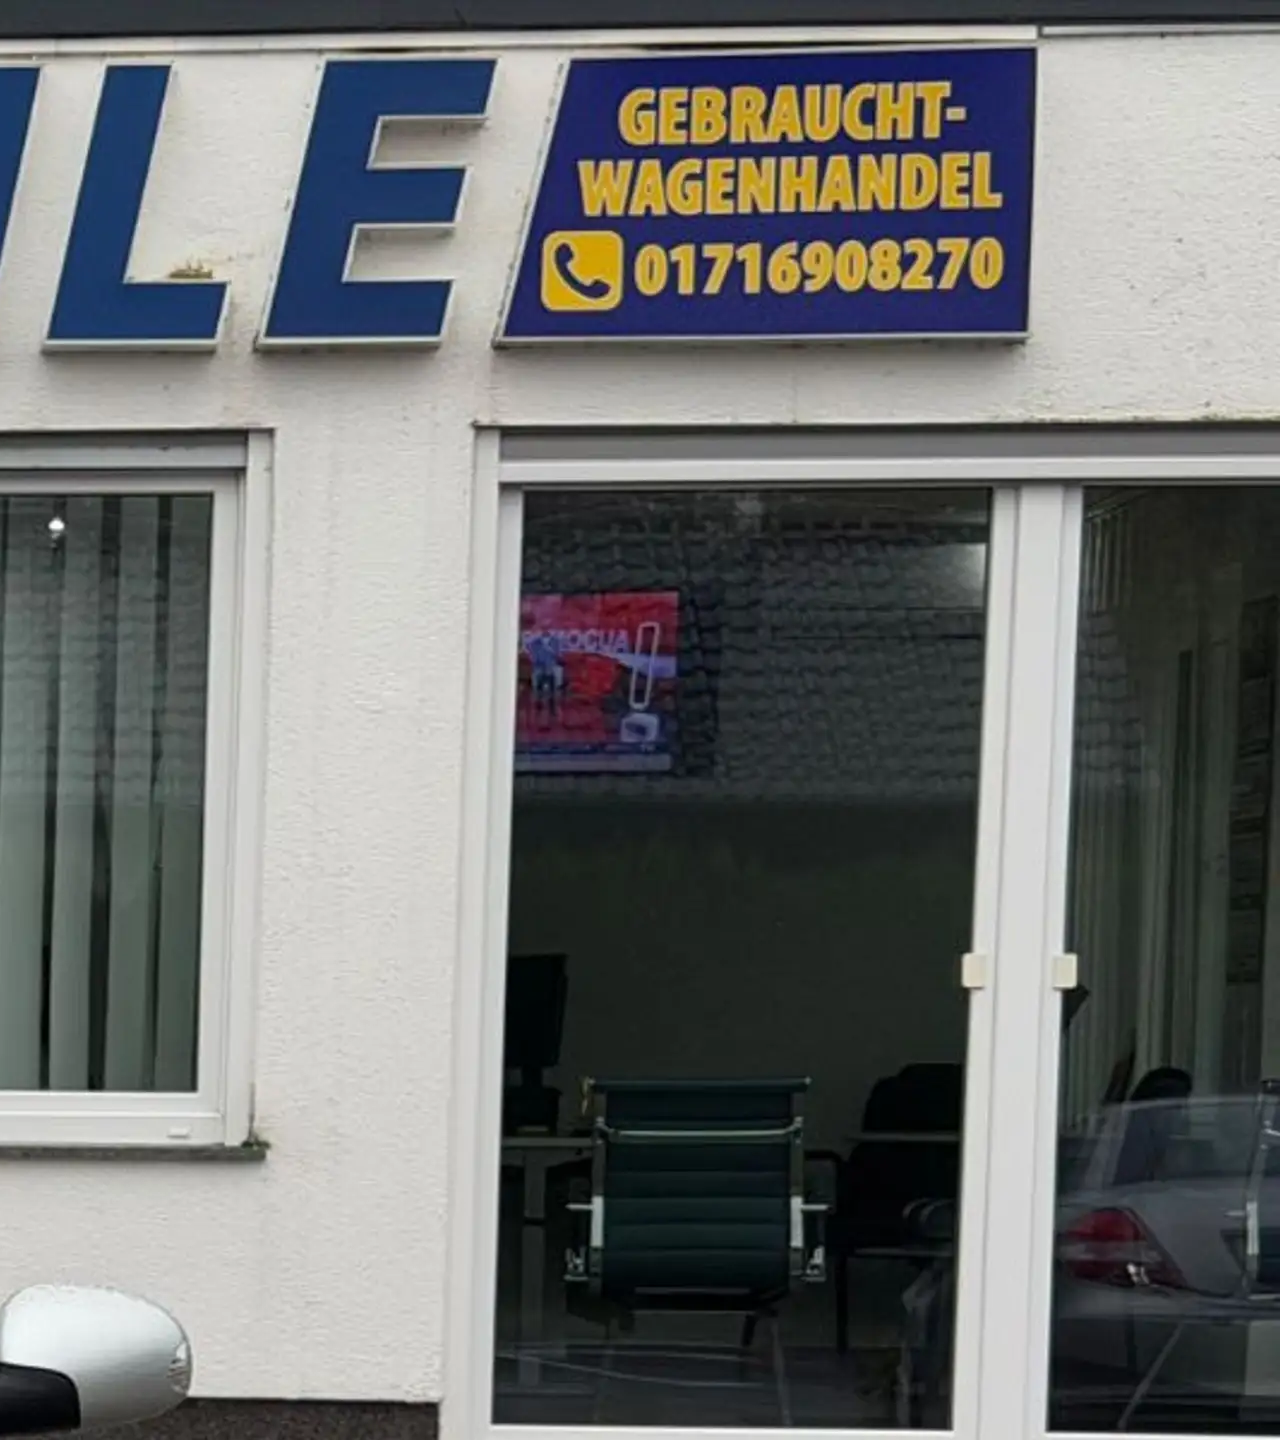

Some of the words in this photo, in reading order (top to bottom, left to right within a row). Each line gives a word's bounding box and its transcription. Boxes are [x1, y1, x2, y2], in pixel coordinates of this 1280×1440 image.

[617, 80, 968, 146] GEBRAUCHT-
[577, 151, 1004, 217] WAGENHANDEL
[633, 236, 1006, 297] 01716908270
